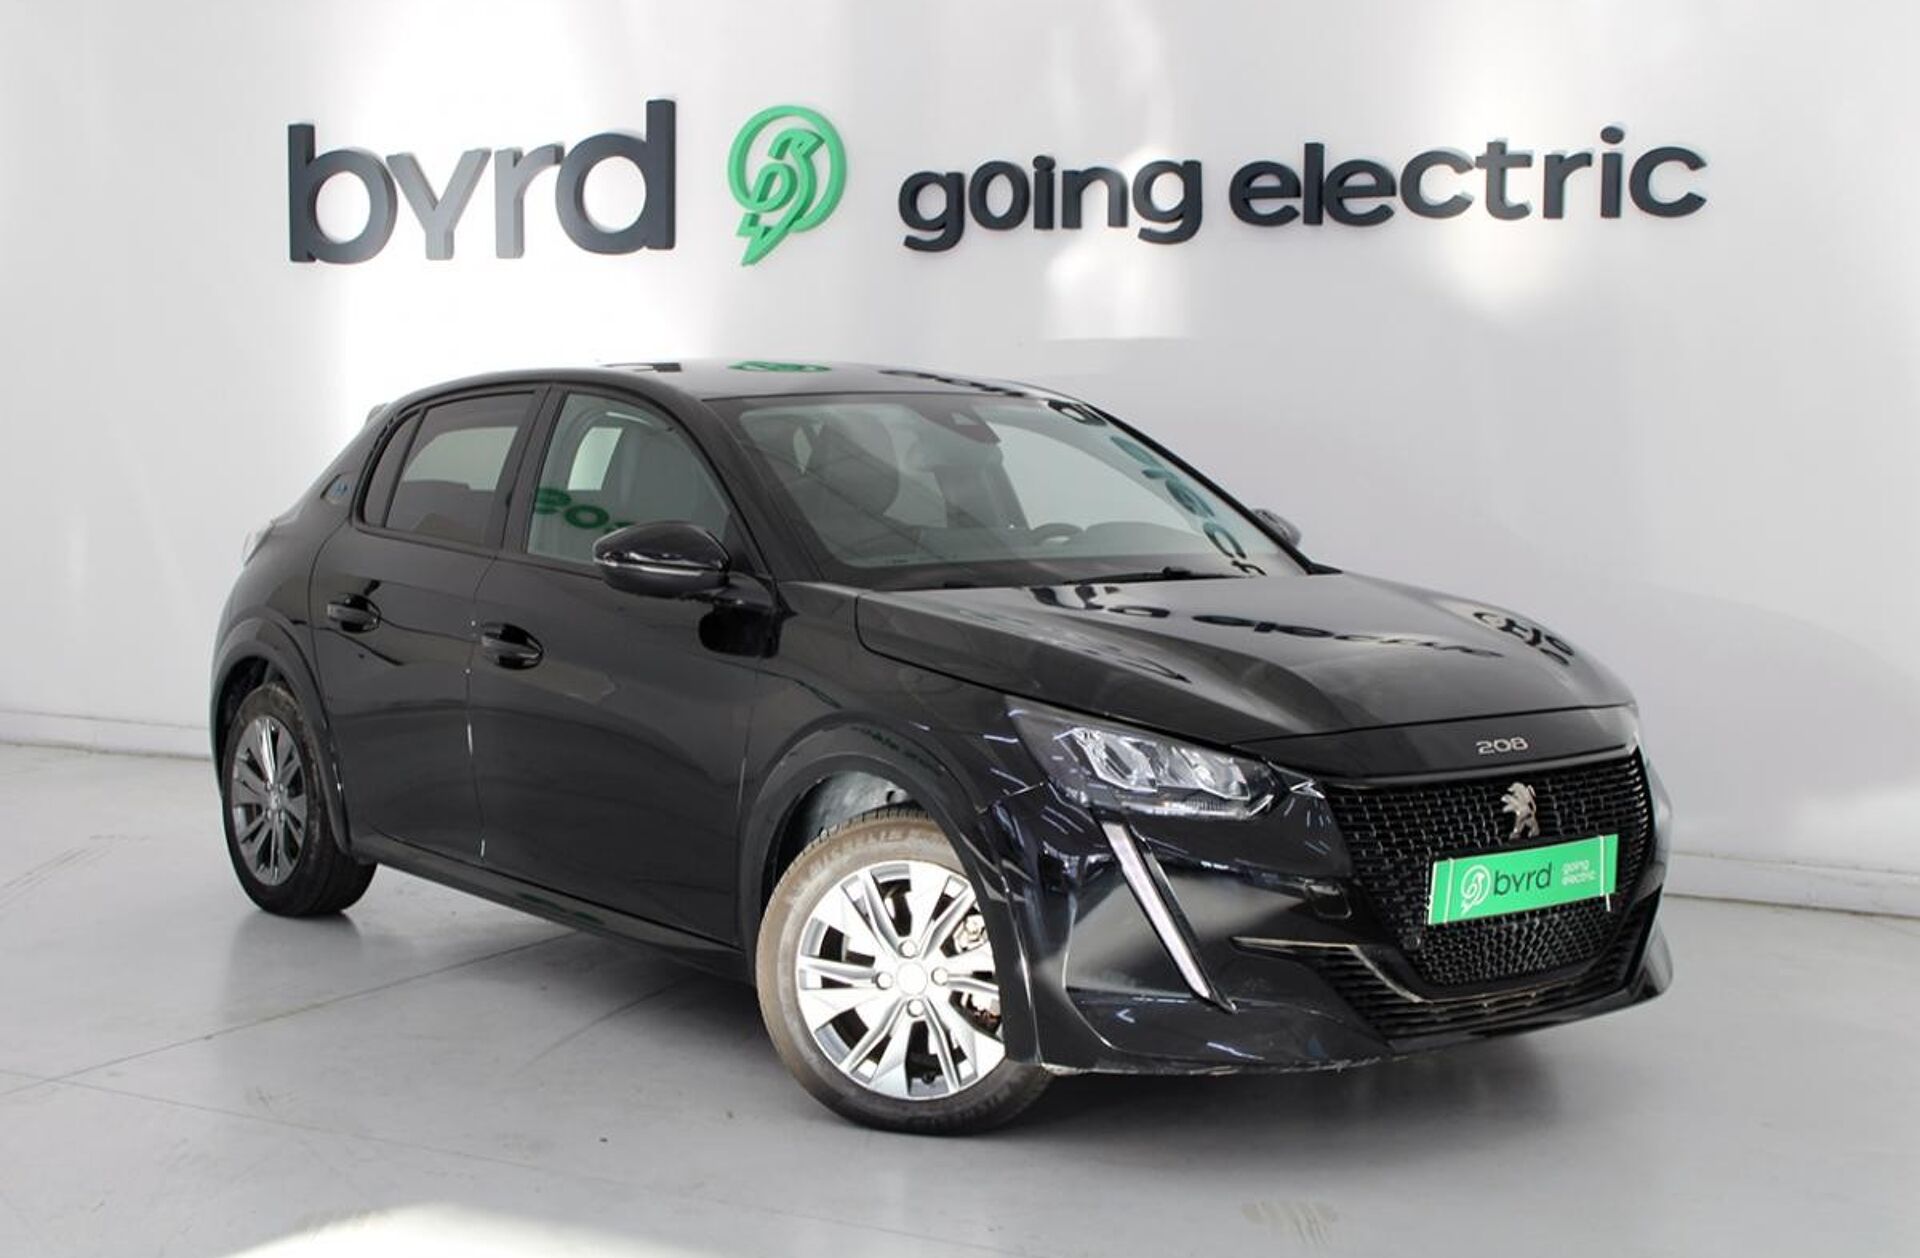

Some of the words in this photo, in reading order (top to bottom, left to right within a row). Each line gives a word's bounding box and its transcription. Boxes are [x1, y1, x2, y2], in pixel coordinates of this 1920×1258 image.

[287, 99, 676, 264] byrd
[898, 155, 1204, 251] going
[1229, 125, 1708, 228] electric
[1476, 737, 1528, 755] 208
[1493, 862, 1552, 896] byrd
